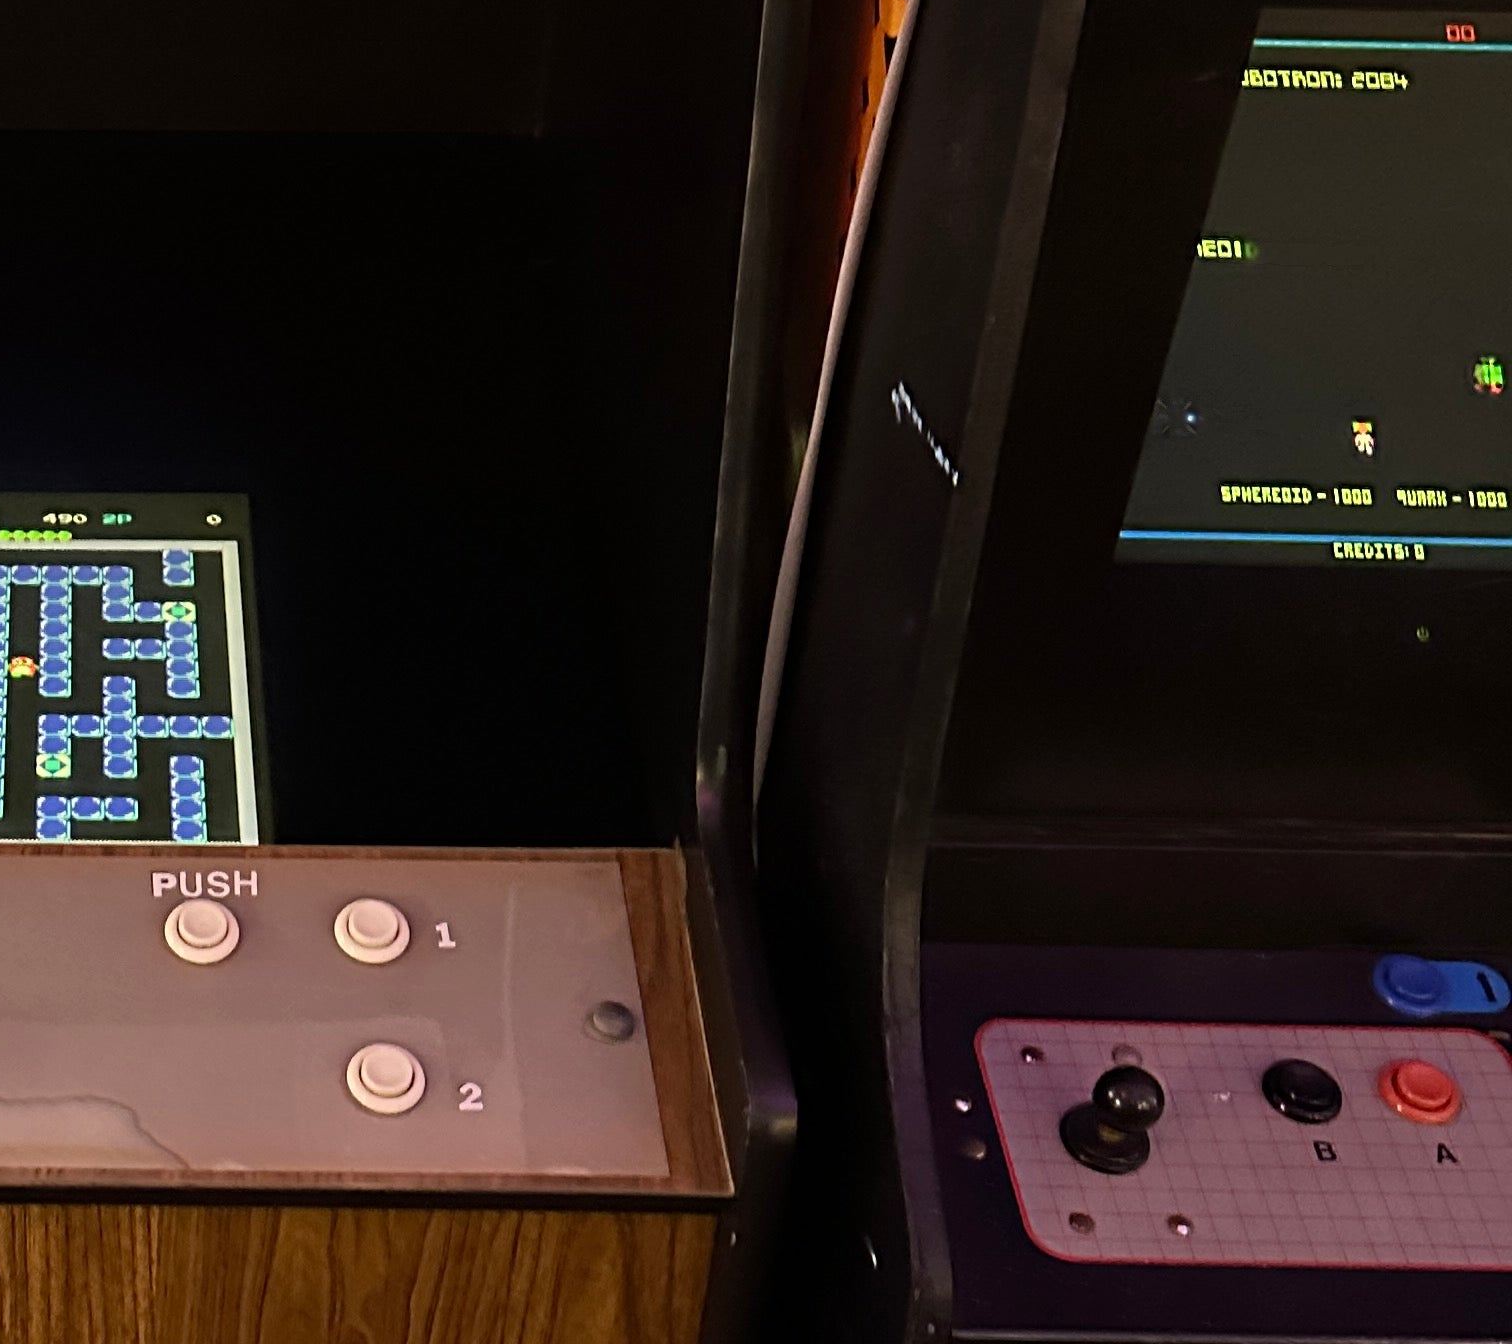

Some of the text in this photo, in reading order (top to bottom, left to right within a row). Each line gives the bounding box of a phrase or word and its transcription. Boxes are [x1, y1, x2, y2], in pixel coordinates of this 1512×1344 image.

[1351, 71, 1409, 91] 2084
[1334, 487, 1373, 506] 1000
[1468, 490, 1509, 508] 1000
[152, 870, 258, 898] PUSH
[435, 921, 456, 948] 1
[458, 1082, 484, 1111] 2
[1313, 1140, 1459, 1164] B A
